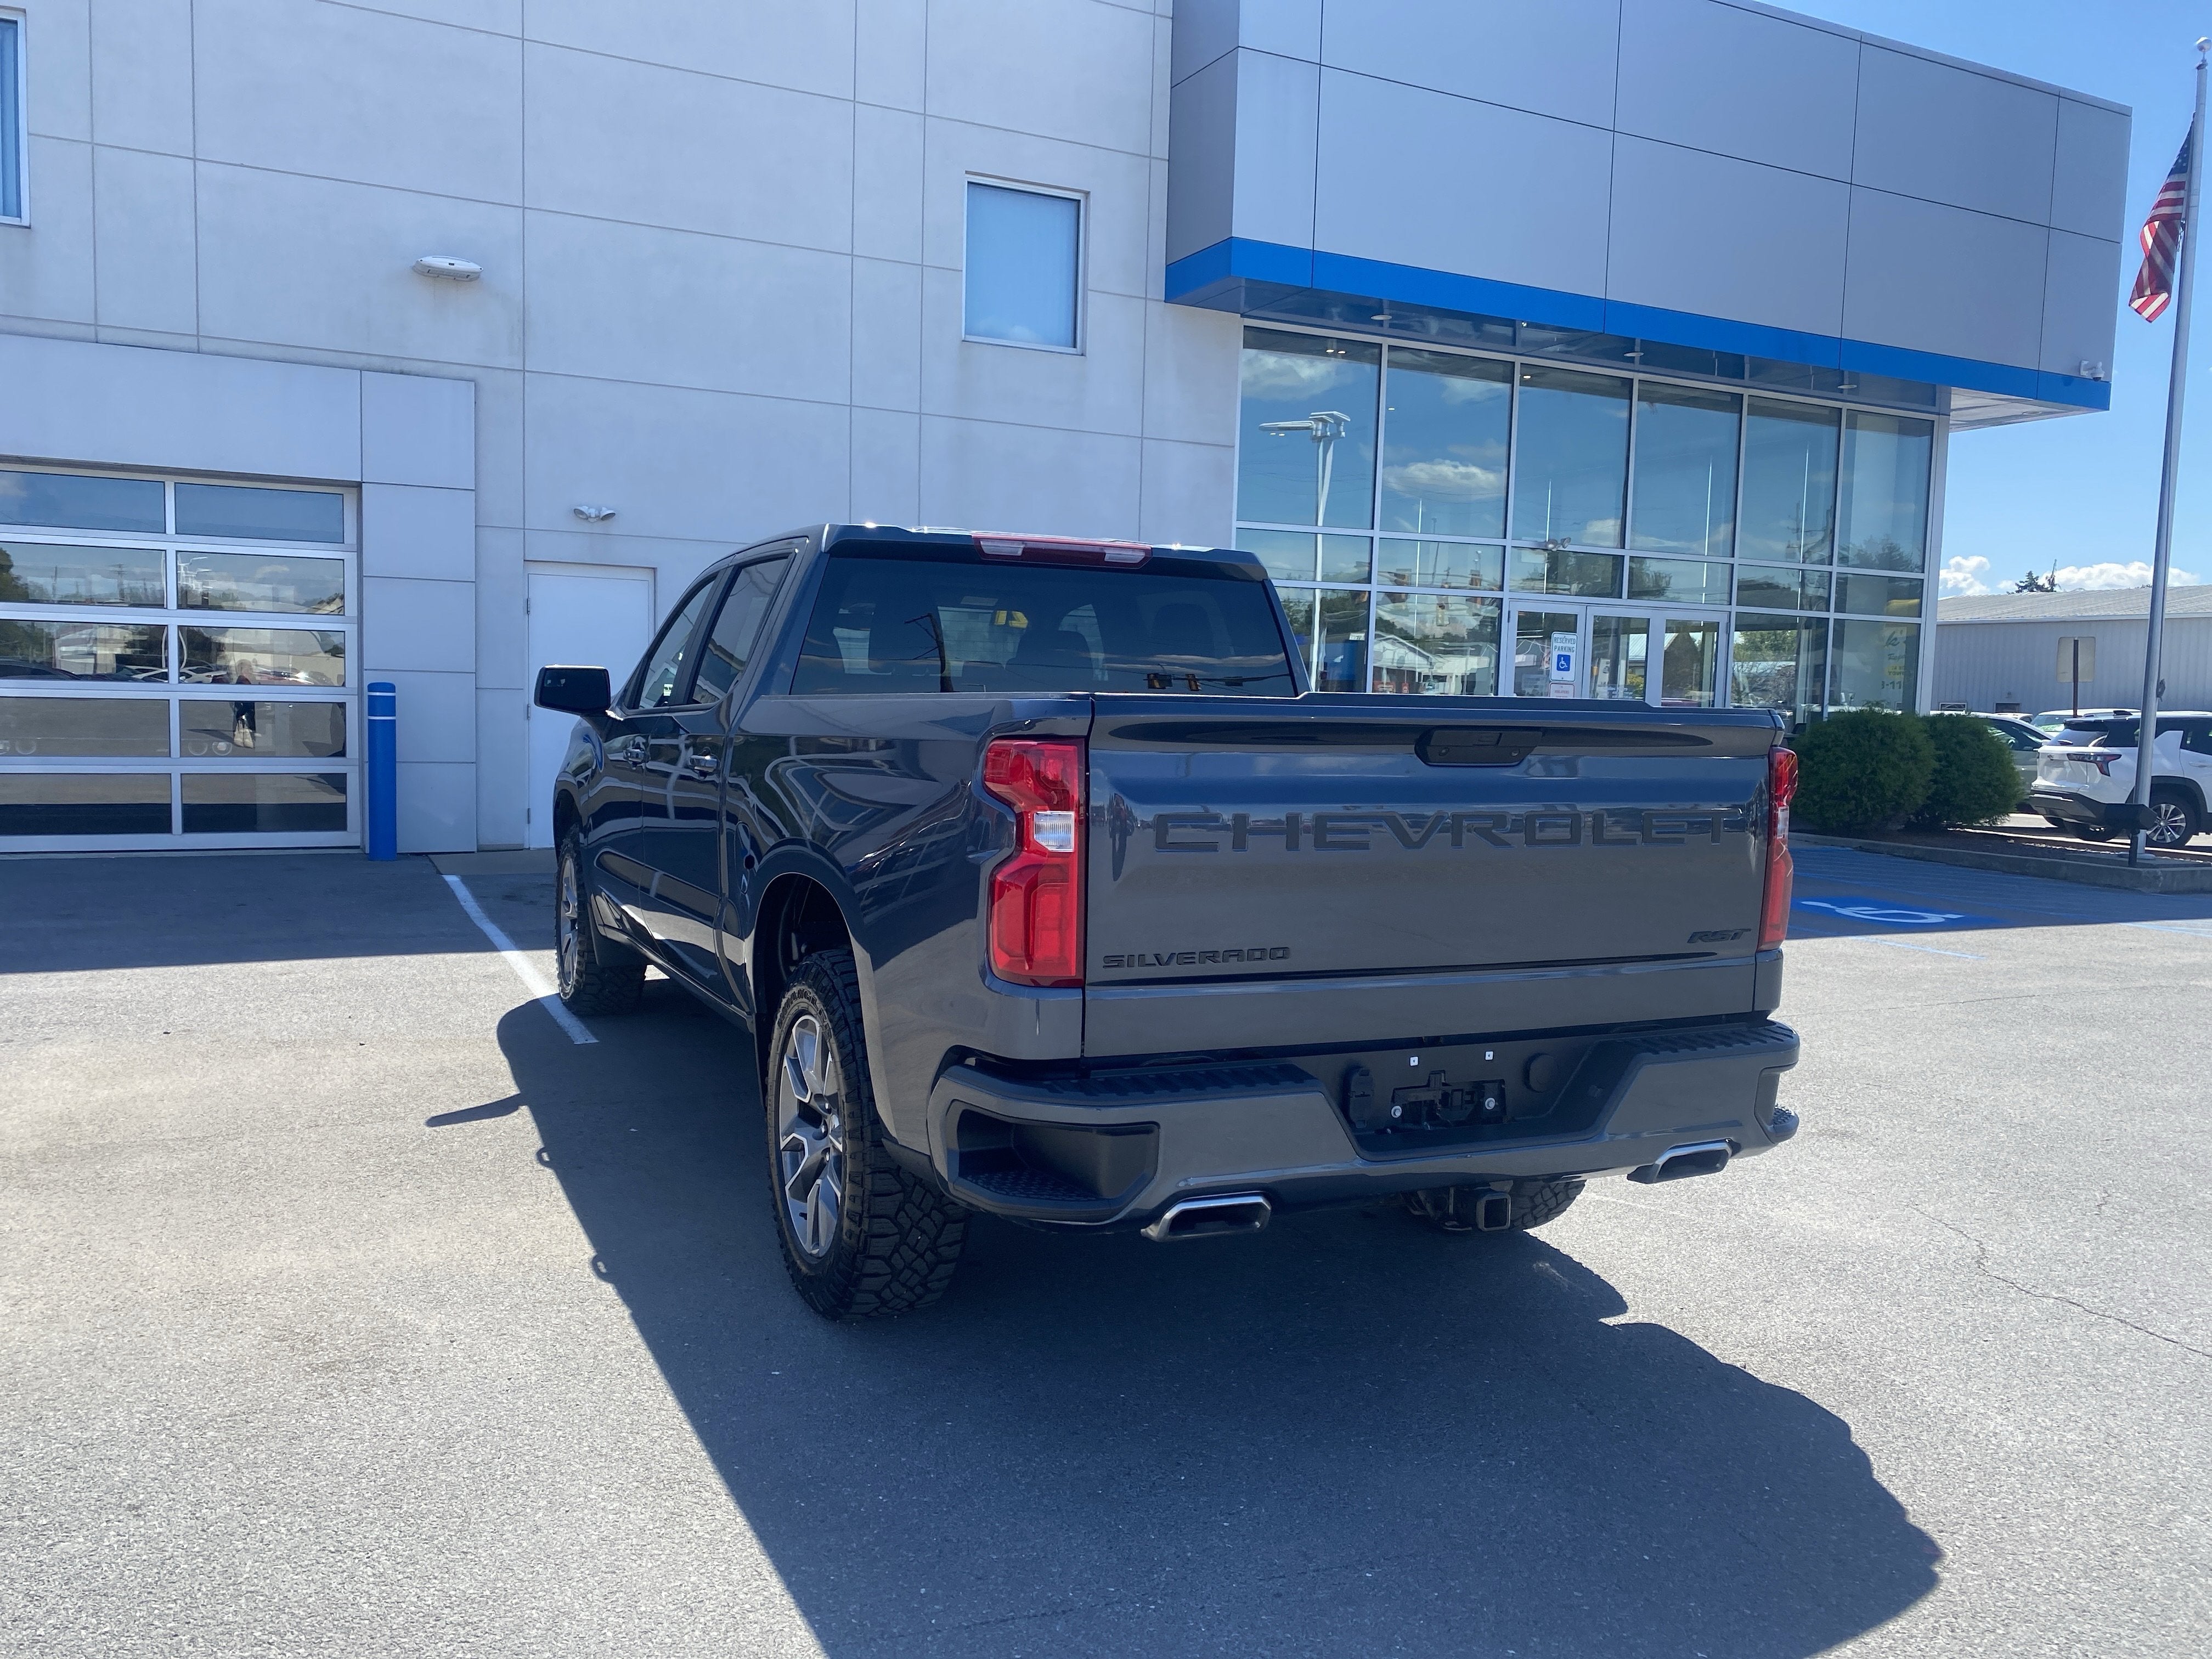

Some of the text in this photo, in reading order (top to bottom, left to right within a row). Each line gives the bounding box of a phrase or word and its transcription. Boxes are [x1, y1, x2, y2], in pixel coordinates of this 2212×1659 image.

[1154, 809, 1743, 852] CHEVROLET
[1686, 928, 1752, 944] RST
[1102, 947, 1290, 969] SILVERADO
